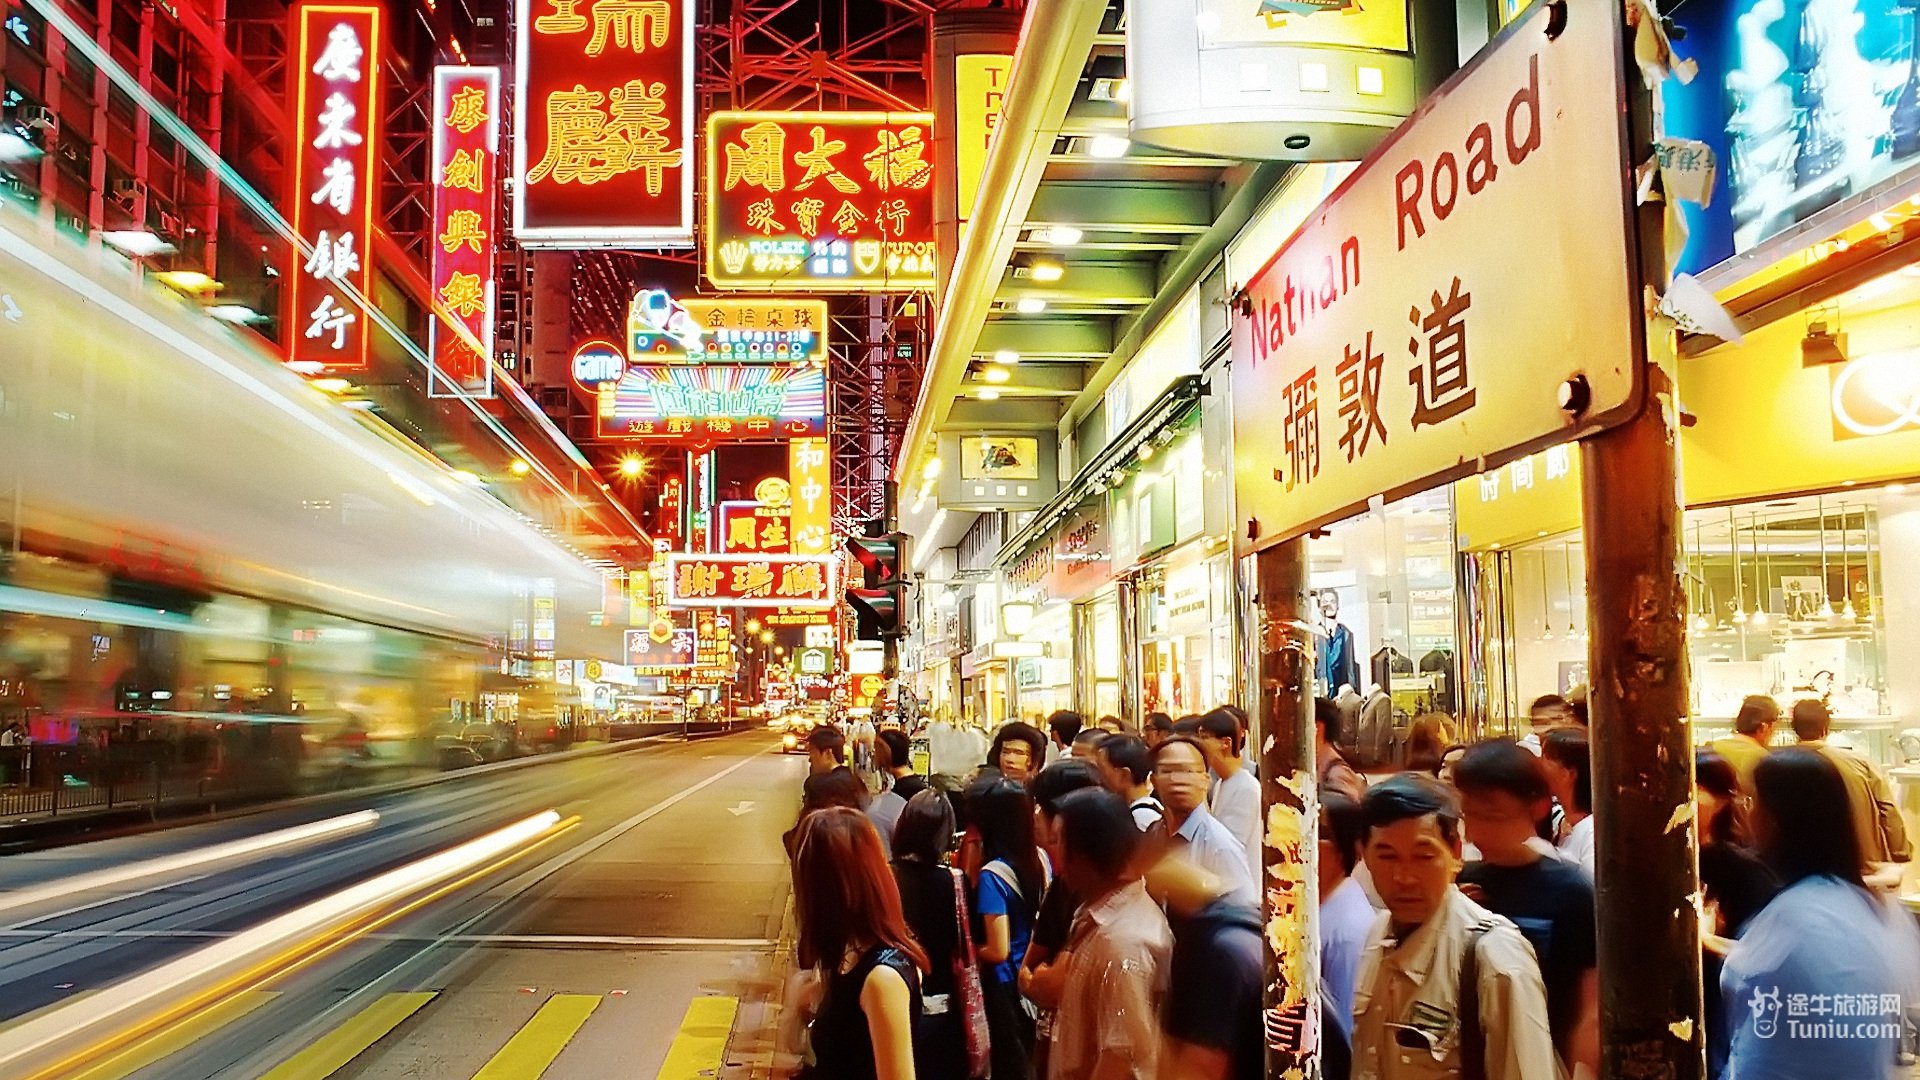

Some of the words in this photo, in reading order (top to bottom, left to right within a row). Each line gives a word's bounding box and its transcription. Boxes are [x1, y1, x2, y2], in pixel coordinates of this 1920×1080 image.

[724, 122, 934, 194] 周大福
[747, 197, 911, 237] 珠寶金行
[1250, 234, 1360, 369] Nathan
[1394, 53, 1542, 252] Road
[750, 241, 806, 255] ROLEX
[1273, 276, 1478, 493] 彌敦道
[628, 419, 808, 434] 遊戲機中心
[677, 561, 827, 600] 謝瑞麟
